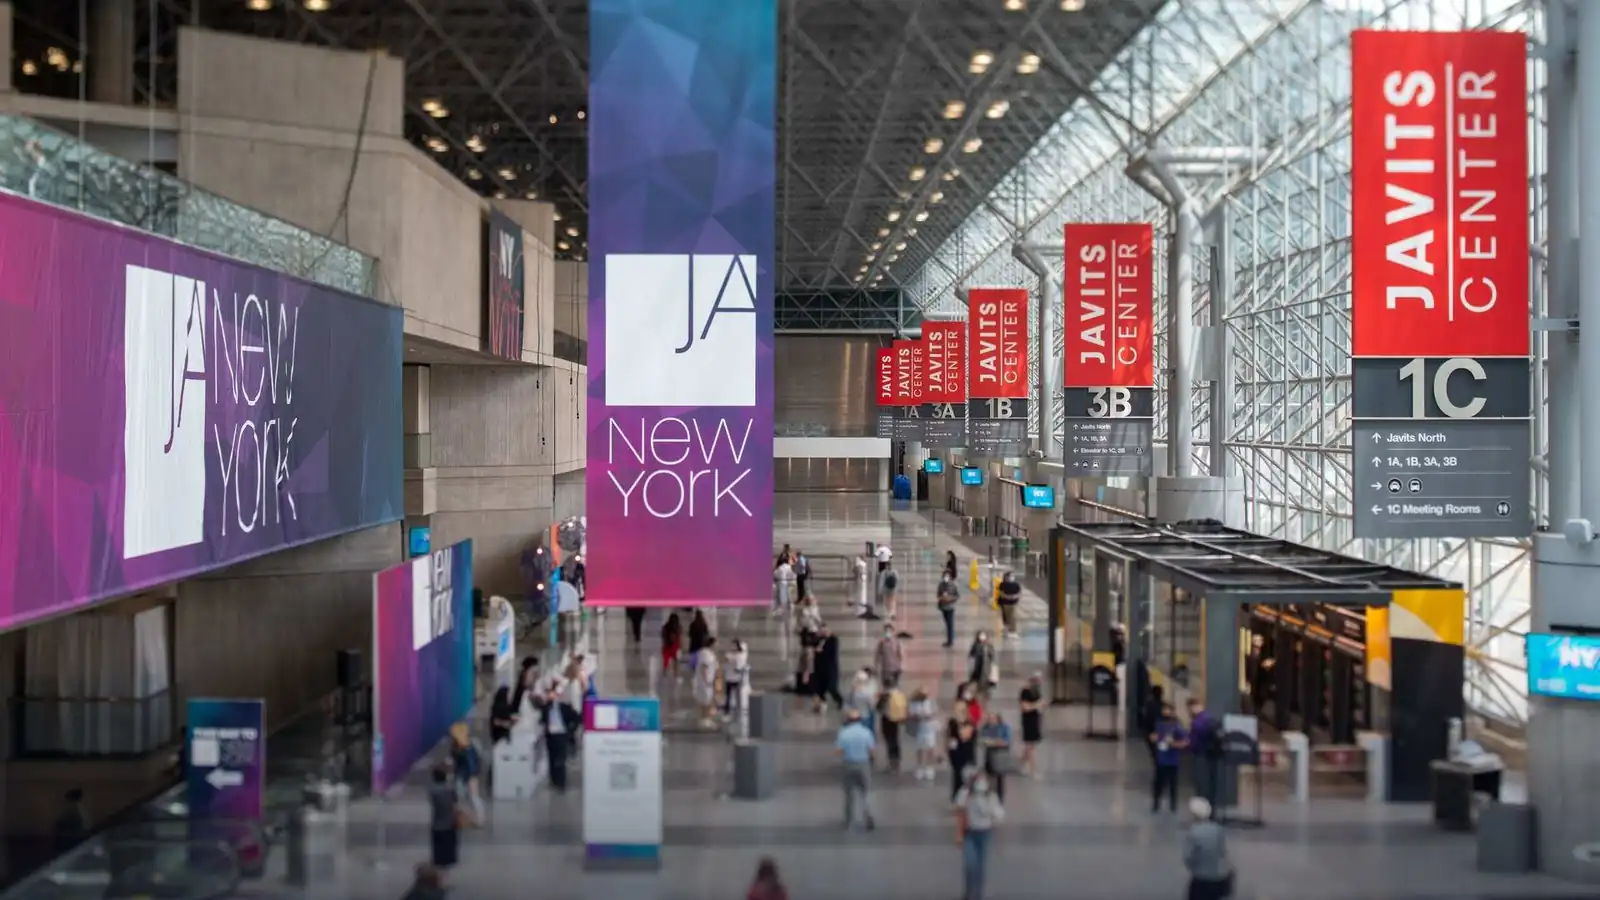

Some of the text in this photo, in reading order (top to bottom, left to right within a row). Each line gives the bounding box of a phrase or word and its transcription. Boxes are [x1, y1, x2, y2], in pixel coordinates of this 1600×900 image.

[1384, 70, 1435, 309] JAVITS
[1458, 70, 1497, 313] CENTER
[675, 254, 756, 354] JA
[1080, 244, 1106, 364] JAVITS
[1118, 244, 1138, 365] CENTER
[929, 331, 943, 392] JAVITS
[948, 331, 959, 393] CENTER
[979, 303, 997, 383] JAVITS
[1004, 302, 1018, 384] CENTER
[882, 355, 892, 398] JAVITS
[899, 348, 910, 397] JAVITS
[913, 348, 922, 397] CENTER
[1400, 358, 1487, 419] 1C
[901, 405, 920, 418] 1A
[931, 402, 956, 419] 3A
[985, 398, 1012, 419] 1B
[1087, 387, 1132, 418] 3B
[1387, 432, 1446, 443] Javits North
[1387, 456, 1457, 468] 1A, 1B, 3A, 3B
[1387, 504, 1481, 516] 1C Meeting Rooms
